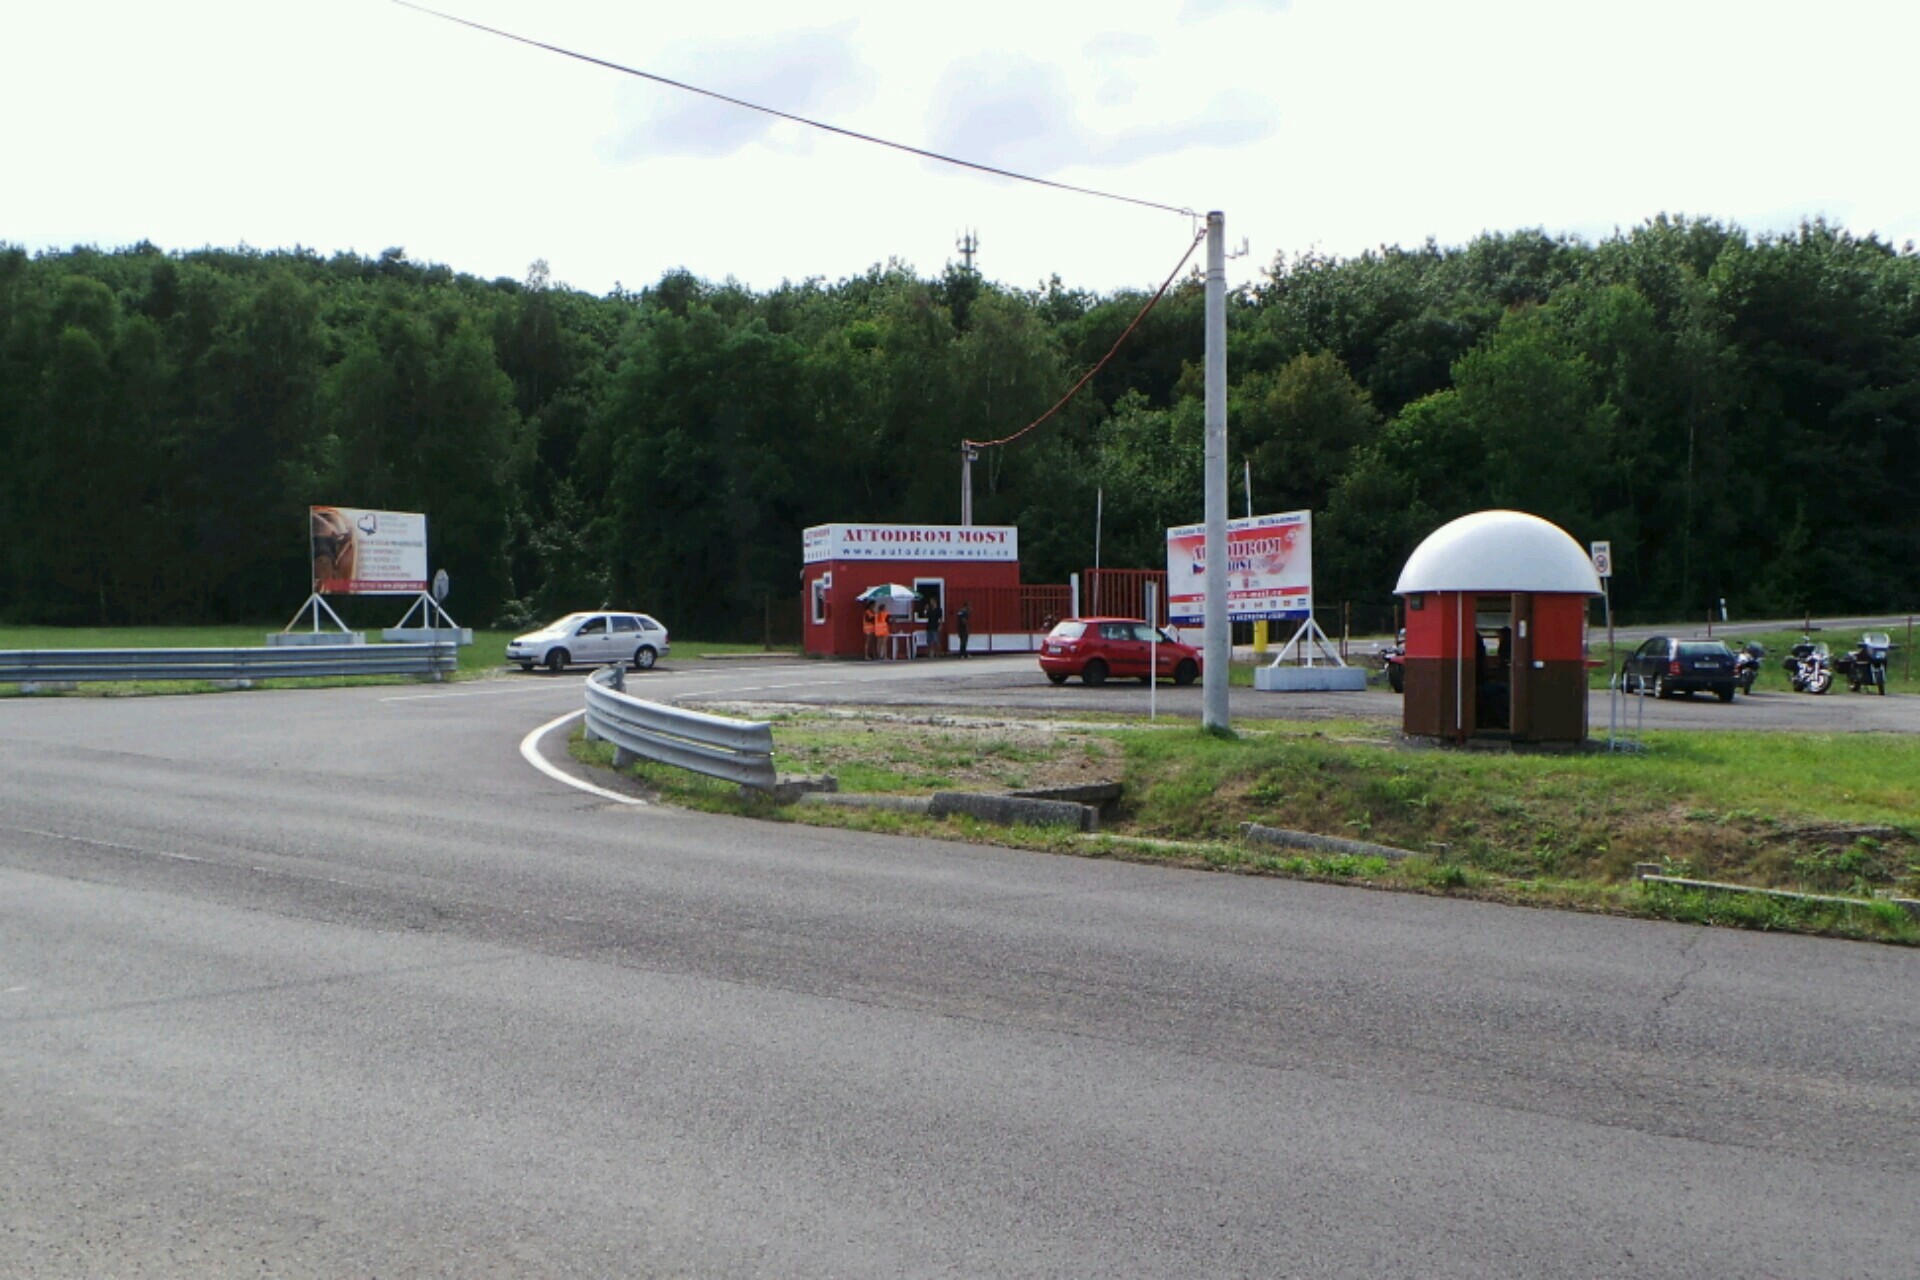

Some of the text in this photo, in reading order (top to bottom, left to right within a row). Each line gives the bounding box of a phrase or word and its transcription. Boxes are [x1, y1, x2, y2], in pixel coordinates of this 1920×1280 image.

[843, 528, 951, 543] AUTODROM
[957, 529, 1009, 544] MOST
[1193, 538, 1281, 561] ADROM
